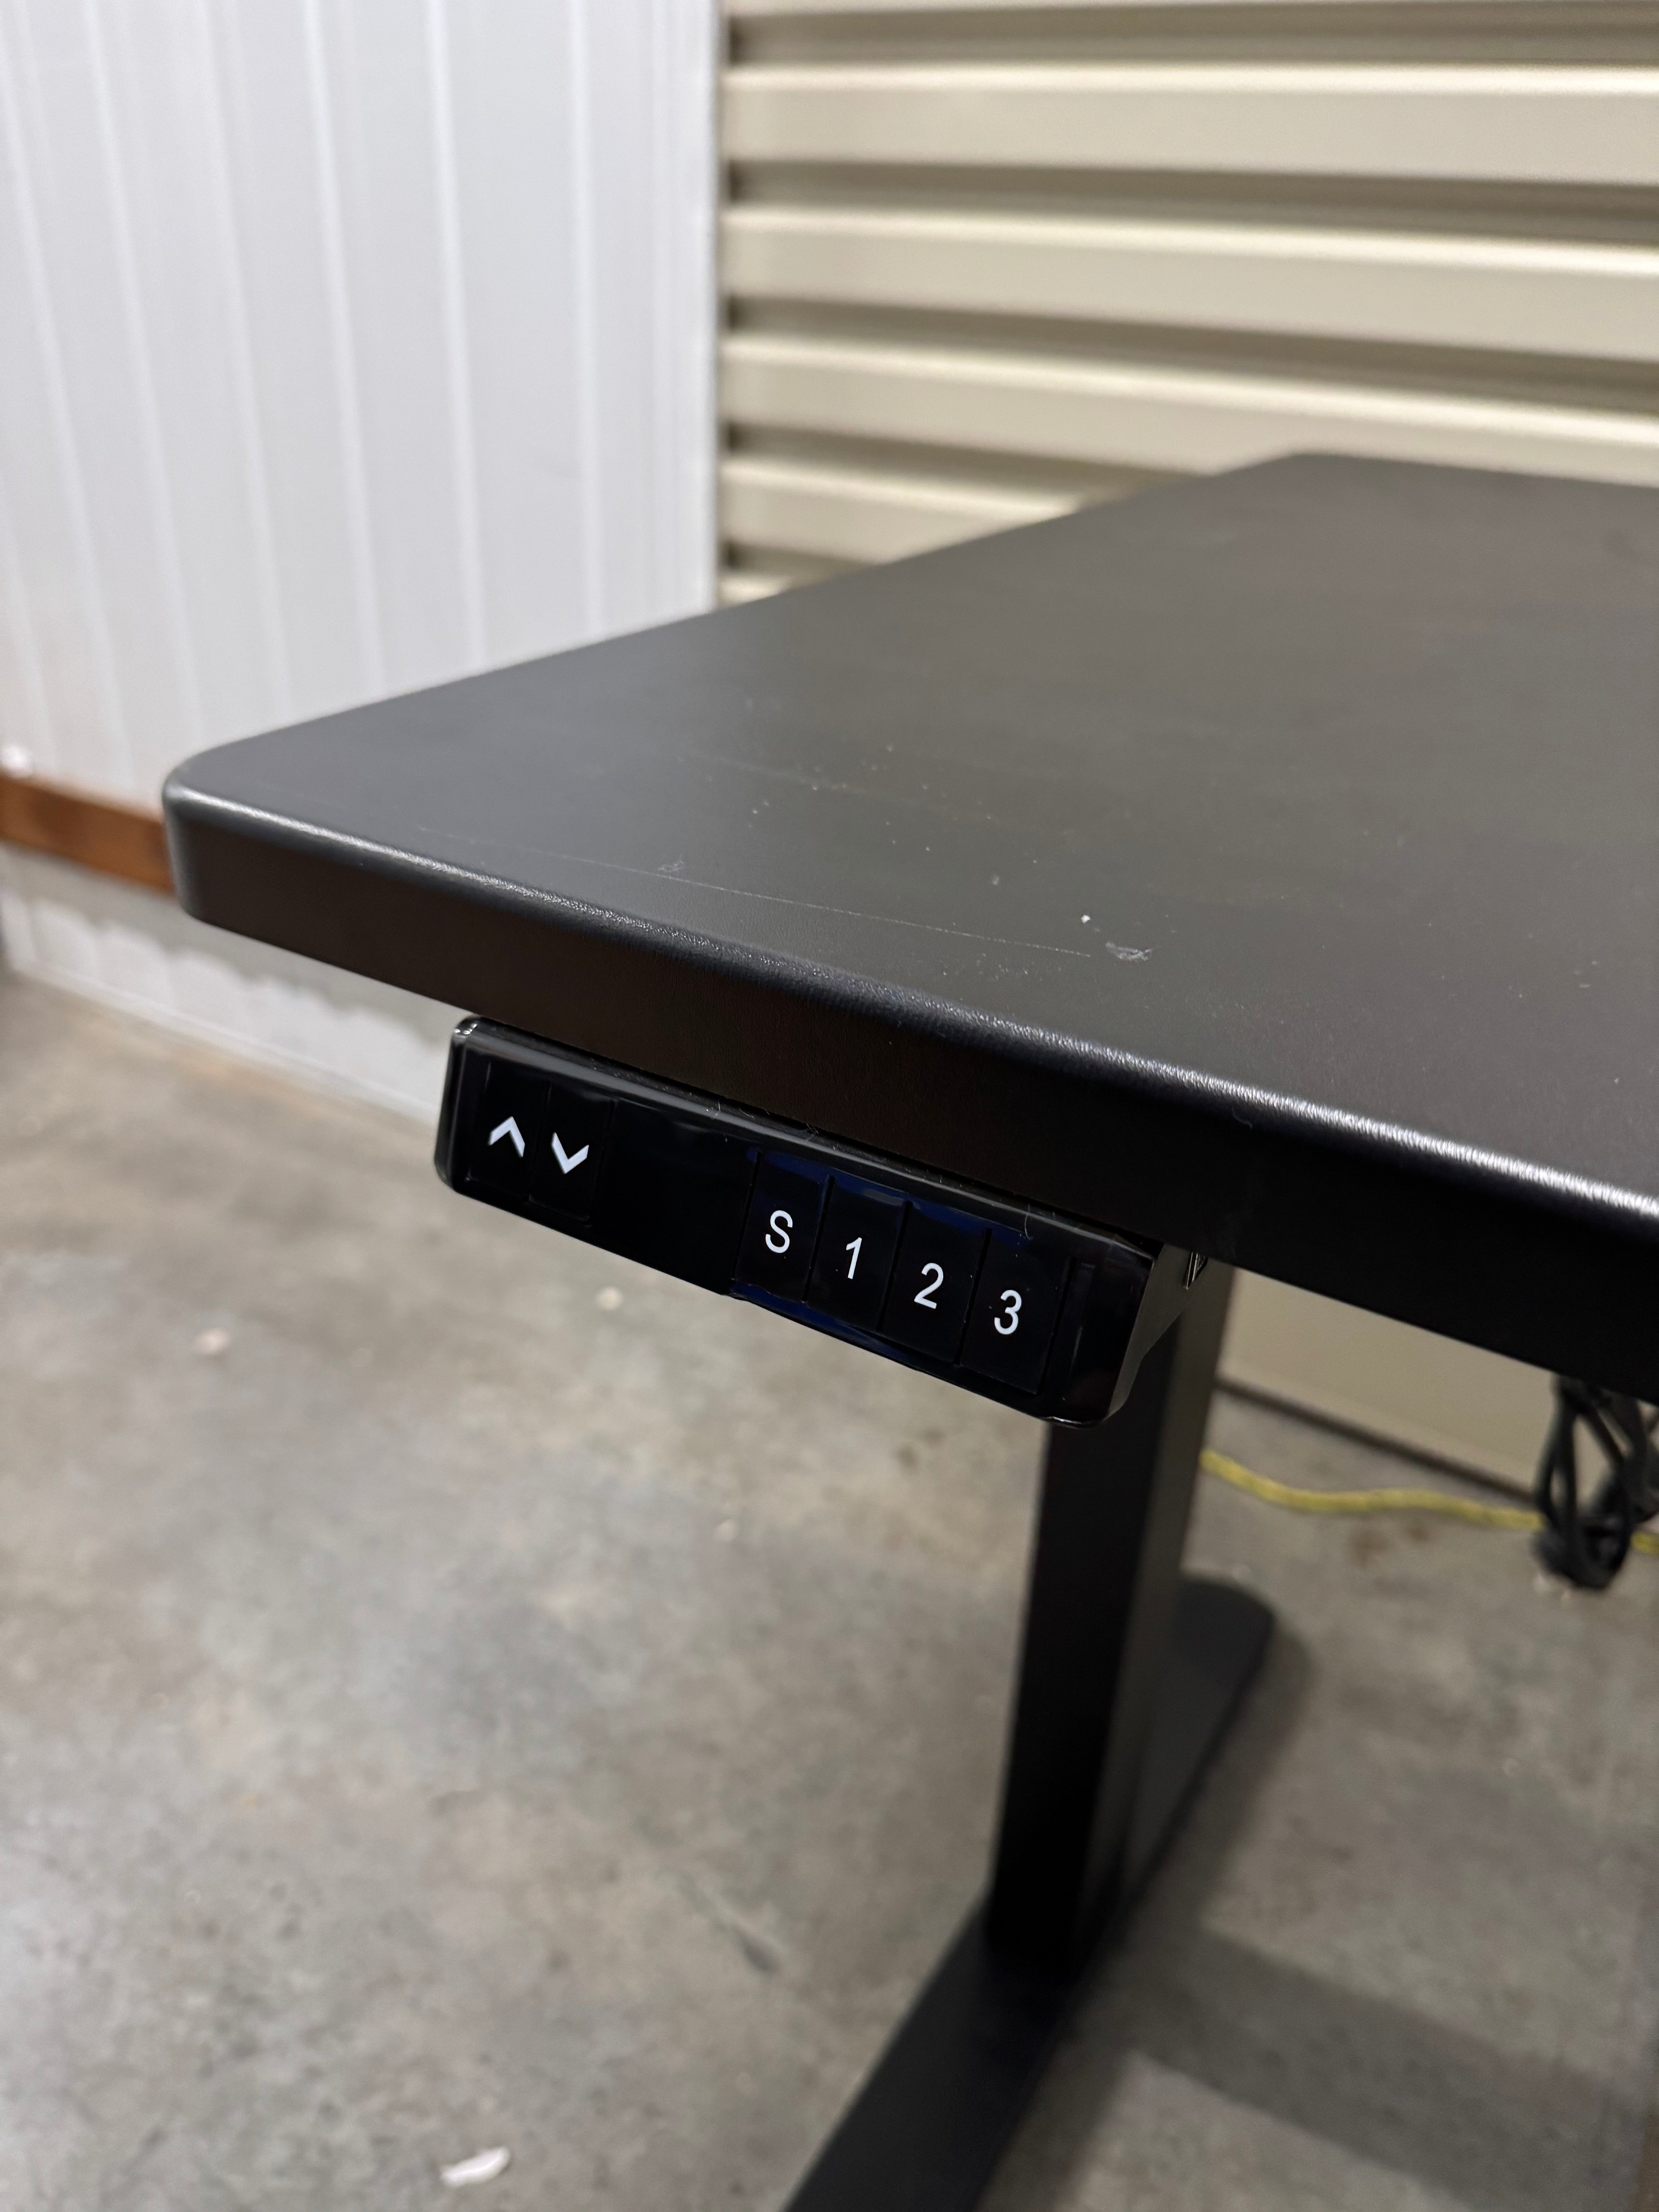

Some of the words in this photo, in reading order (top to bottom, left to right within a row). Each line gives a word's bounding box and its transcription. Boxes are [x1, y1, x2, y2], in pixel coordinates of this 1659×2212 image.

[765, 1209, 793, 1254] S
[845, 1237, 862, 1280] 1
[914, 1262, 944, 1309] 2
[994, 1289, 1022, 1335] 3
